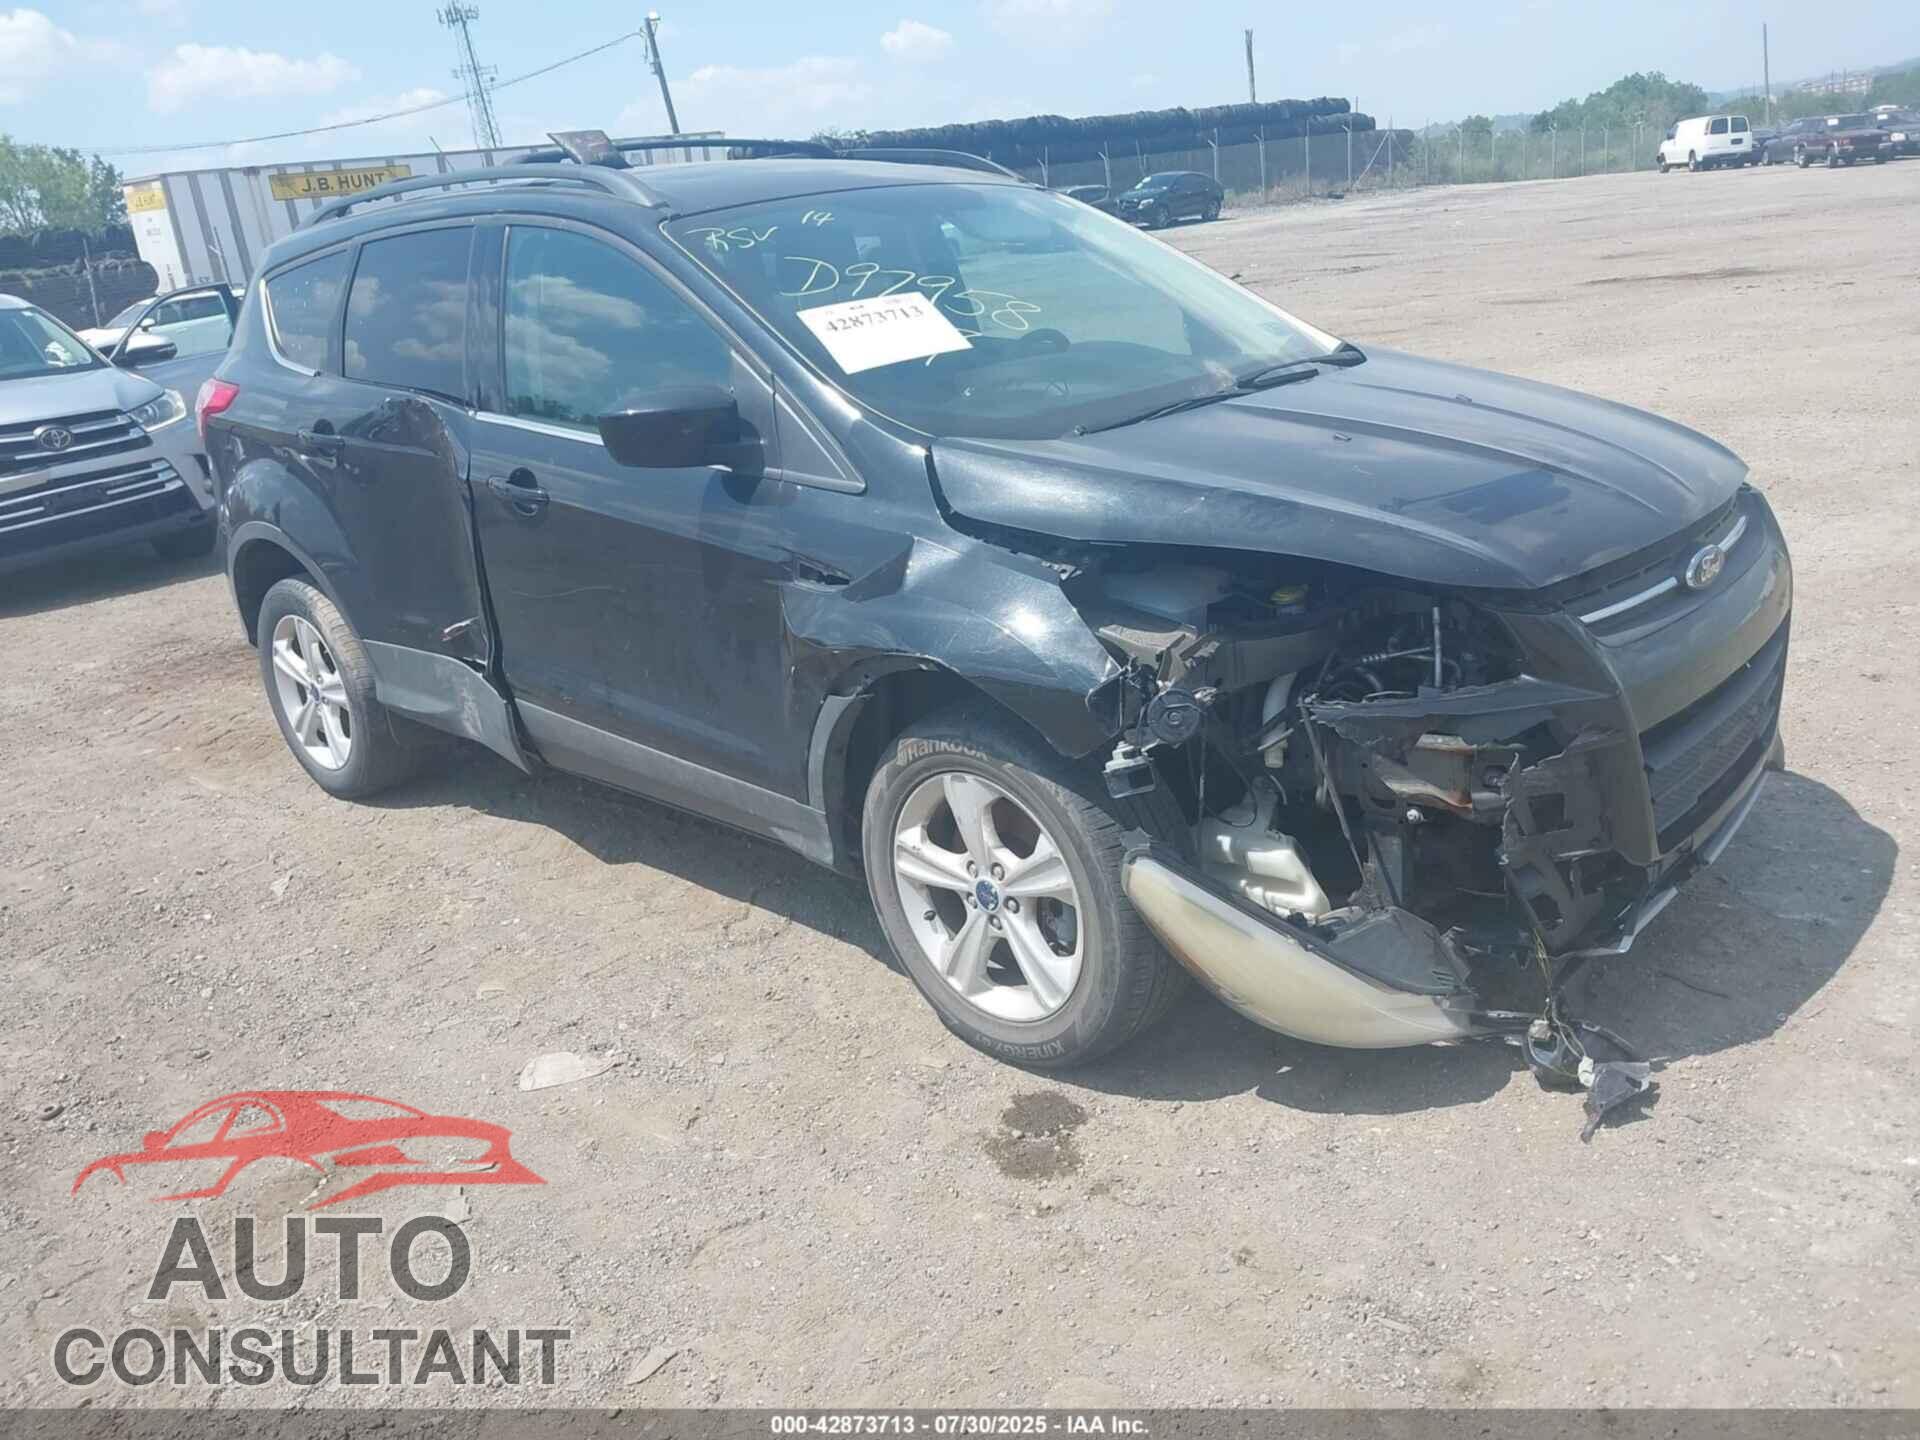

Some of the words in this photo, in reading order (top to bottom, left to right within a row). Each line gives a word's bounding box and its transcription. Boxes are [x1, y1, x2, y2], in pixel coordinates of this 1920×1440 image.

[302, 176, 334, 193] J.B.
[337, 173, 384, 190] HUNT
[826, 304, 924, 333] 42873713
